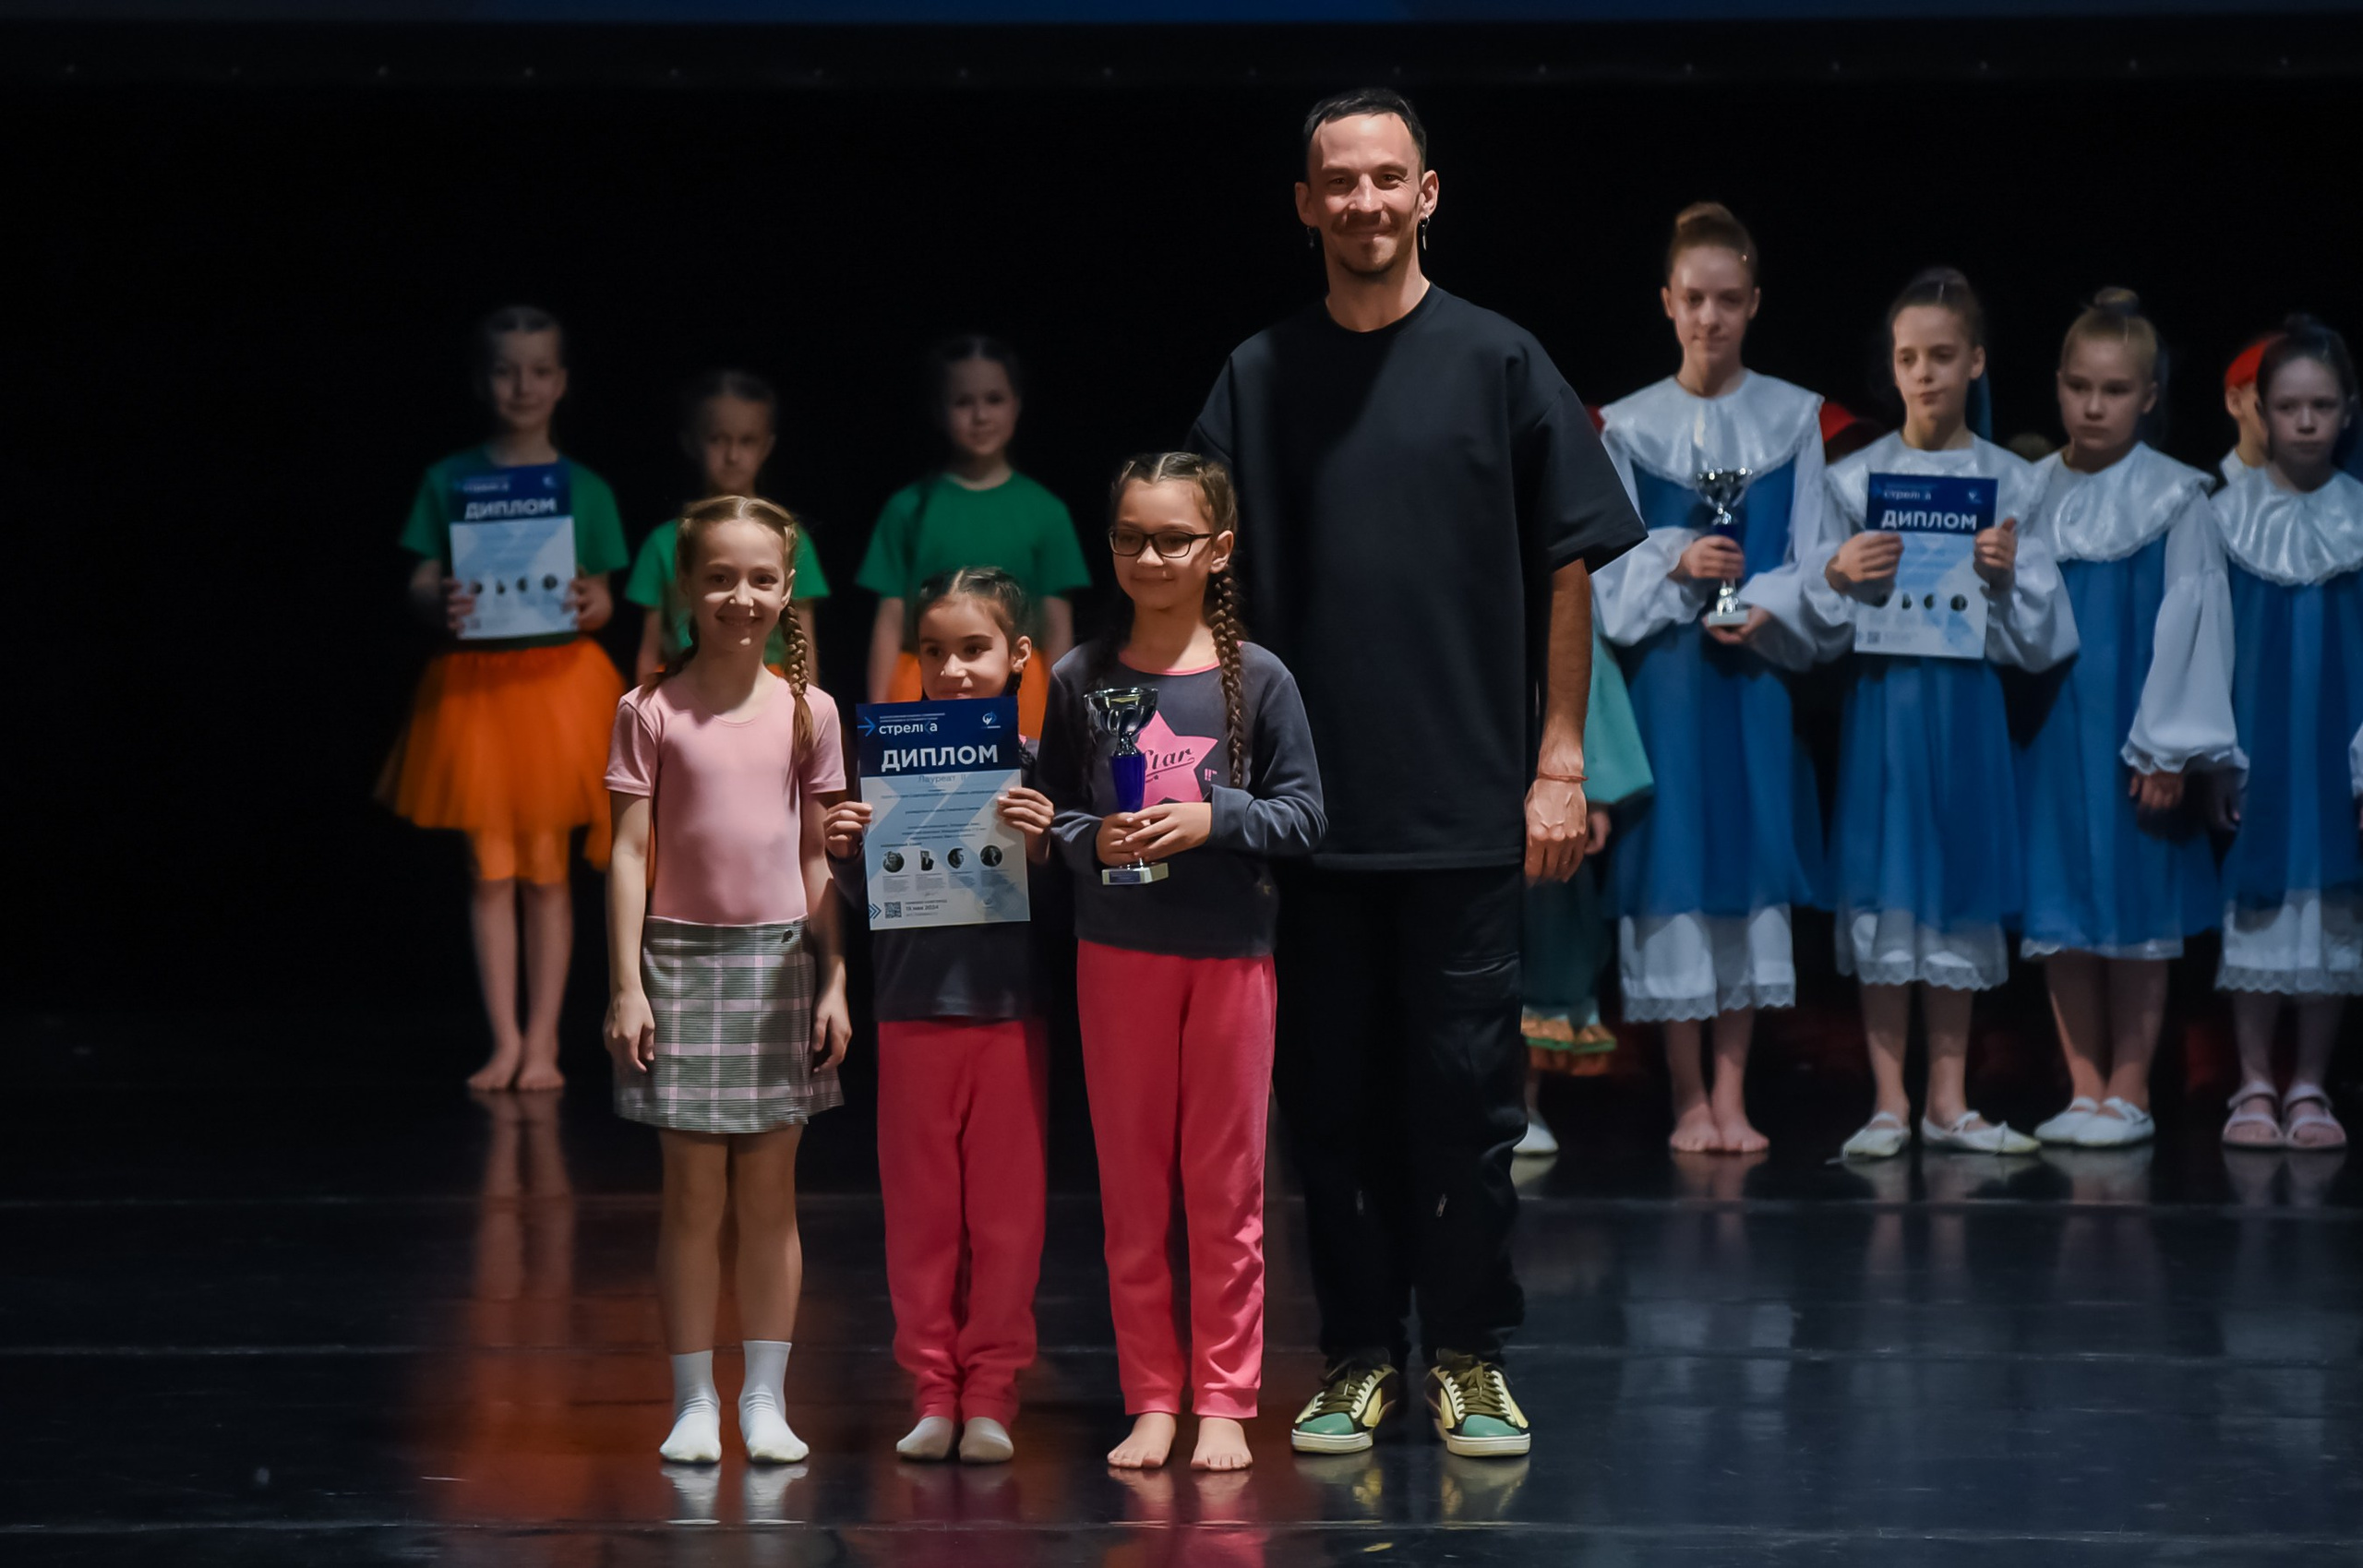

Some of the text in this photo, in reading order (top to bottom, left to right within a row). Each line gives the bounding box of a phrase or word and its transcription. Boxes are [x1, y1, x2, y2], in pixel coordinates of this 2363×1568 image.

[464, 497, 558, 521] ДИПЛОМ
[1881, 509, 1977, 531] ДИПЛОМ
[881, 745, 999, 772] ДИПЛОМ
[918, 775, 955, 784] Лауреат
